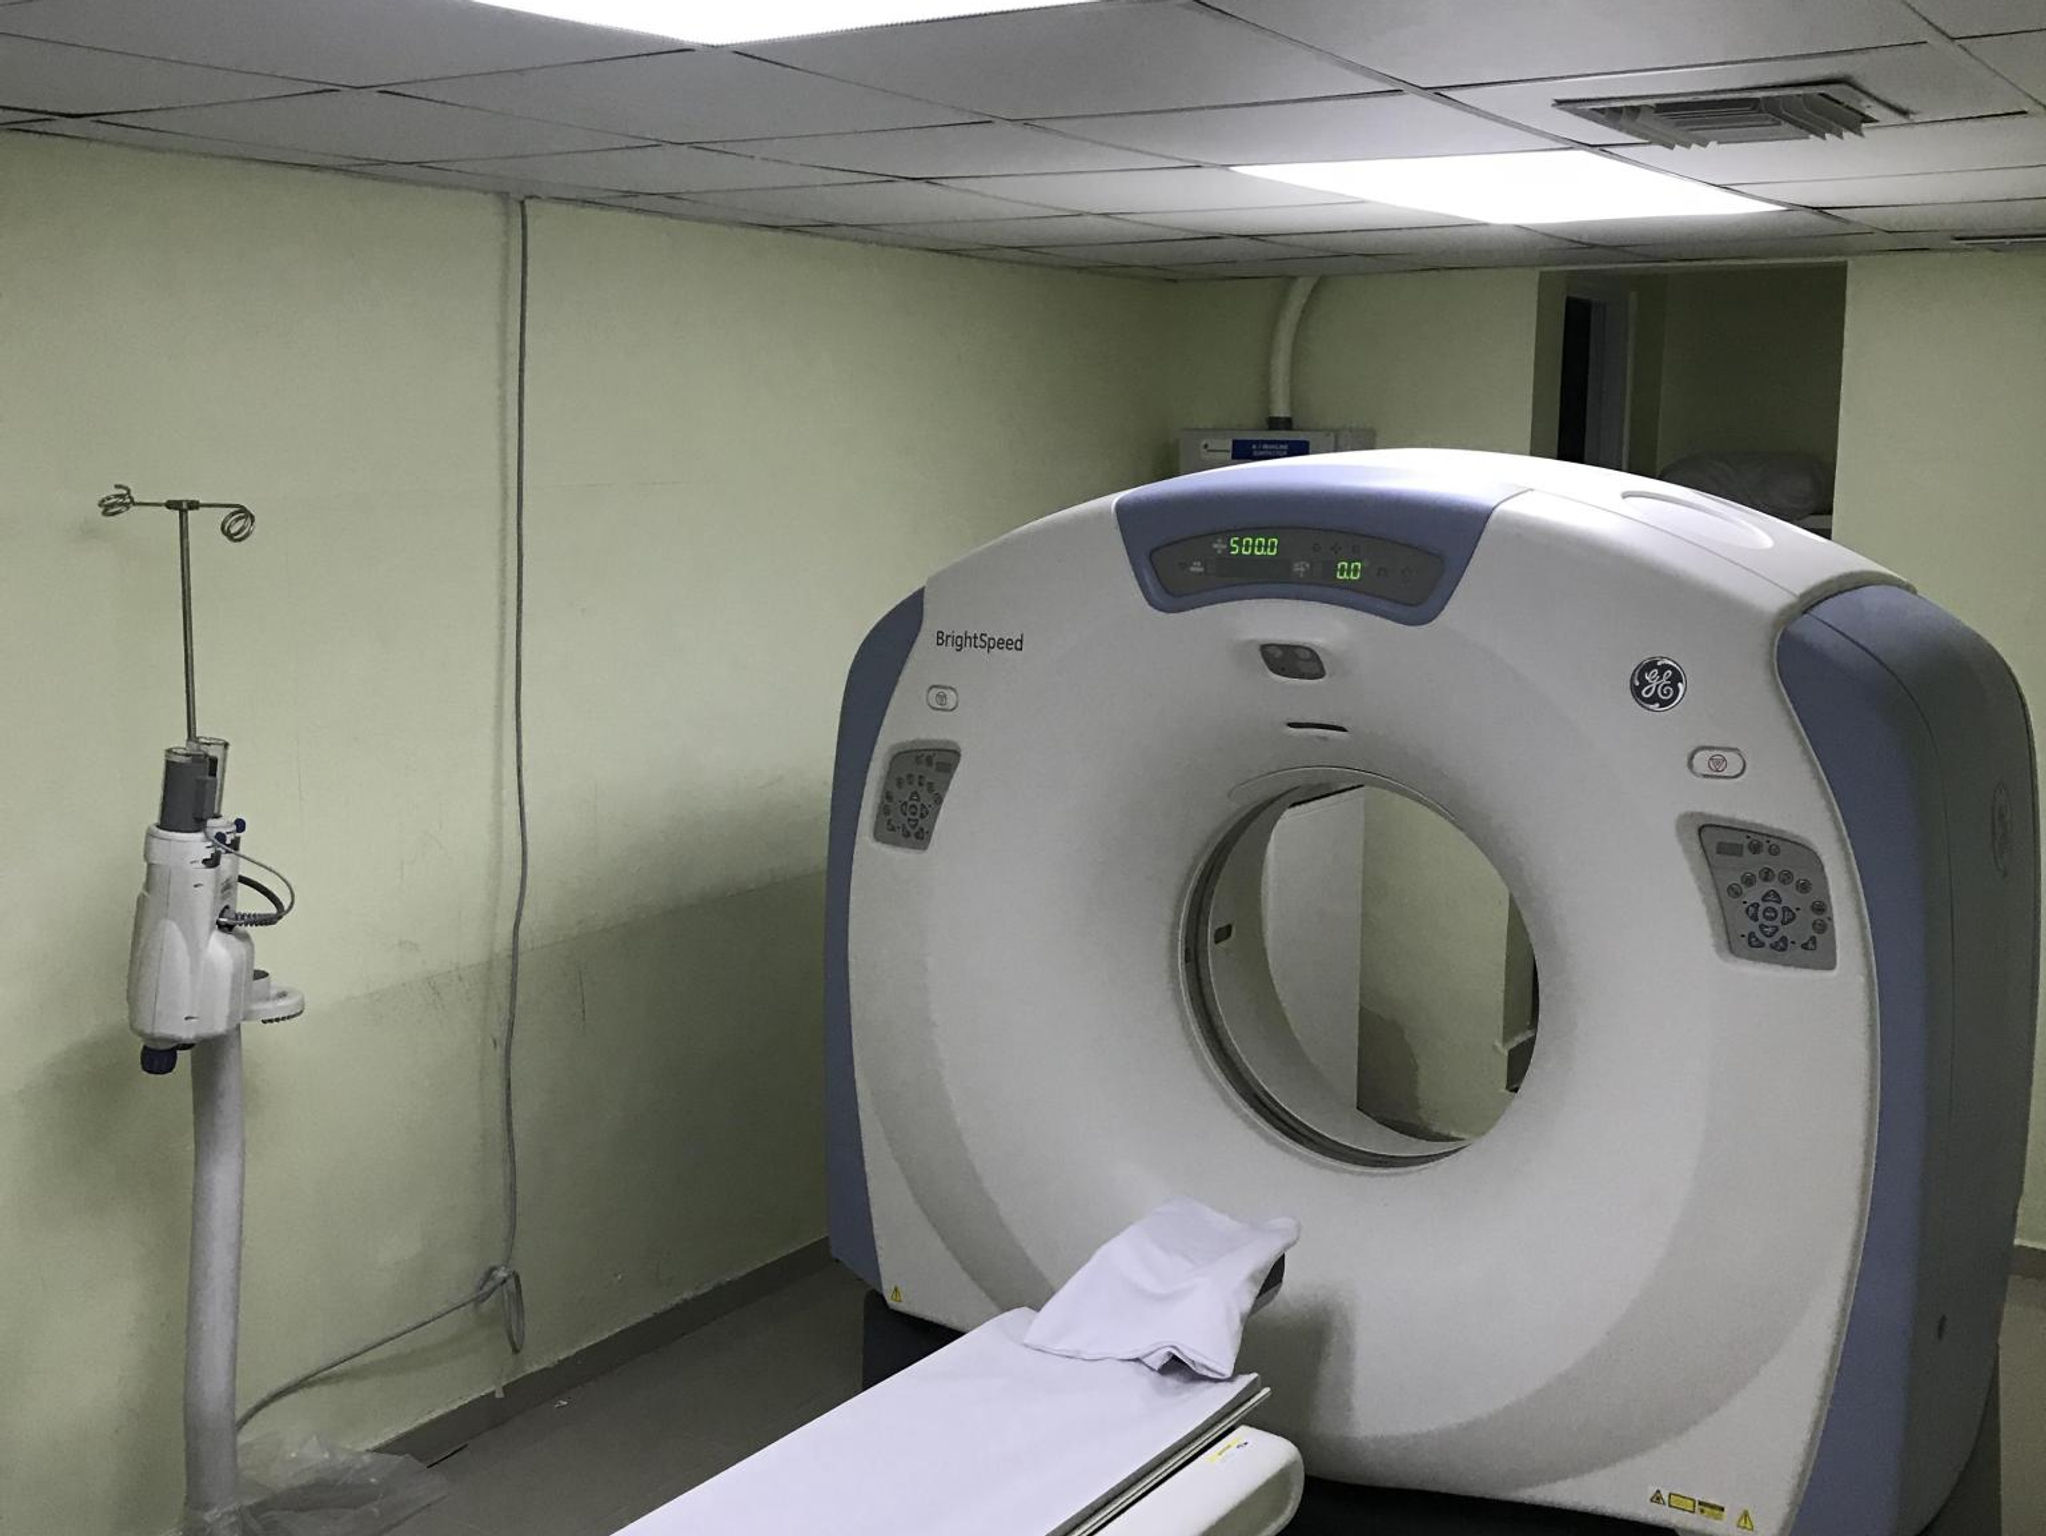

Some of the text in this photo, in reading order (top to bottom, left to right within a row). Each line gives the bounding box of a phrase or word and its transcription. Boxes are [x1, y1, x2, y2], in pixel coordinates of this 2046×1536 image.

[1229, 537, 1279, 556] 500.0
[1336, 561, 1362, 580] 0.0
[936, 630, 1023, 653] BrightSpeed
